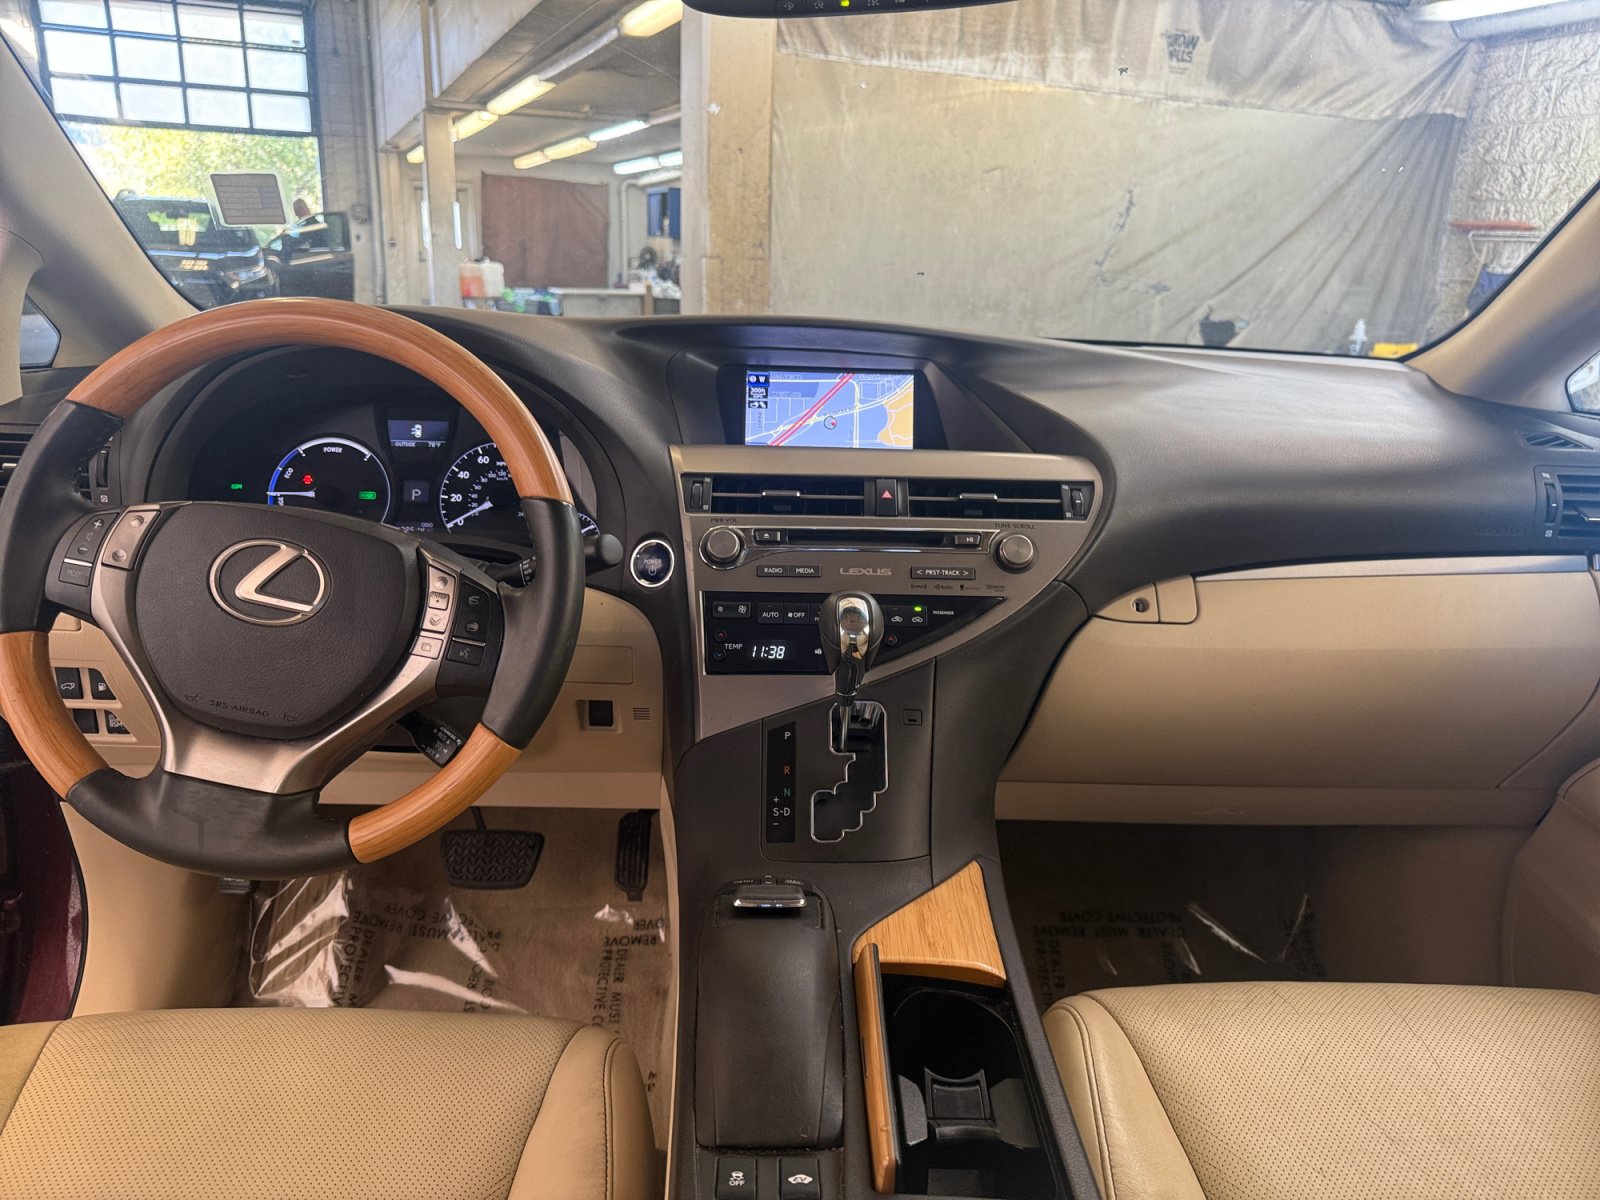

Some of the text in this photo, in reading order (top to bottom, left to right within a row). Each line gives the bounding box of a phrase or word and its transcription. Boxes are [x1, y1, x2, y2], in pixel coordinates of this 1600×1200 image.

[477, 456, 490, 464] 60
[284, 467, 294, 479] ECO
[458, 471, 470, 479] 40
[412, 489, 421, 500] P
[450, 494, 463, 502] 20
[839, 567, 892, 576] LEXUS
[752, 645, 785, 659] 11:38
[784, 731, 791, 740] P
[784, 766, 791, 774] R
[784, 788, 791, 796] N
[383, 902, 426, 921] COVER
[352, 910, 450, 939] MUST REMOVE
[604, 935, 657, 946] REMOVE
[354, 929, 375, 983] DEALER
[593, 950, 613, 1011] PROTECTIVE
[609, 949, 628, 1024] DEALER MUST
